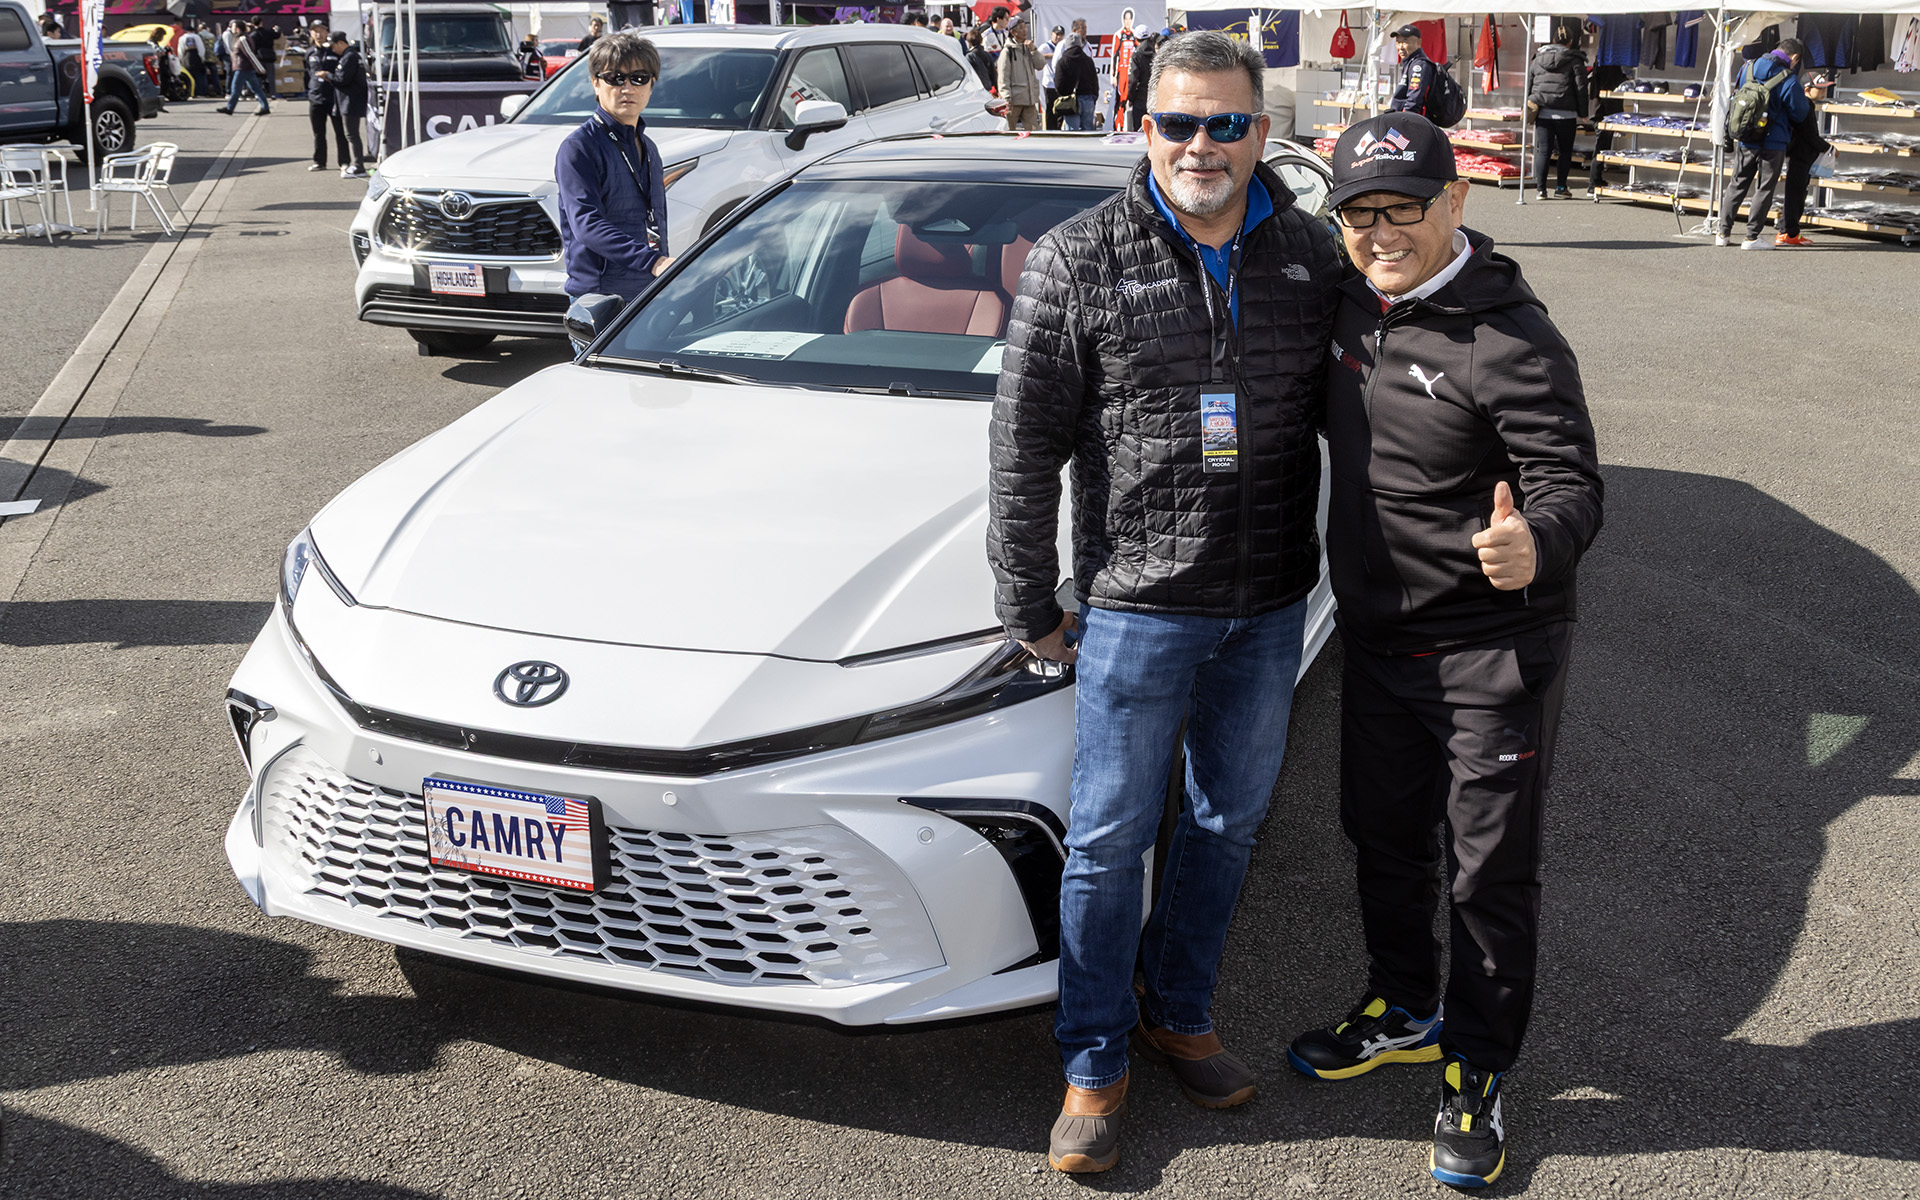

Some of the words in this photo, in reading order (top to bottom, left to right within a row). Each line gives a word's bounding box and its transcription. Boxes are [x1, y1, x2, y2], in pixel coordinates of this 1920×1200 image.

[1351, 156, 1375, 168] Super
[1374, 153, 1402, 161] Taikyu
[436, 271, 478, 288] HIGHLANDER
[445, 806, 567, 864] CAMRY
